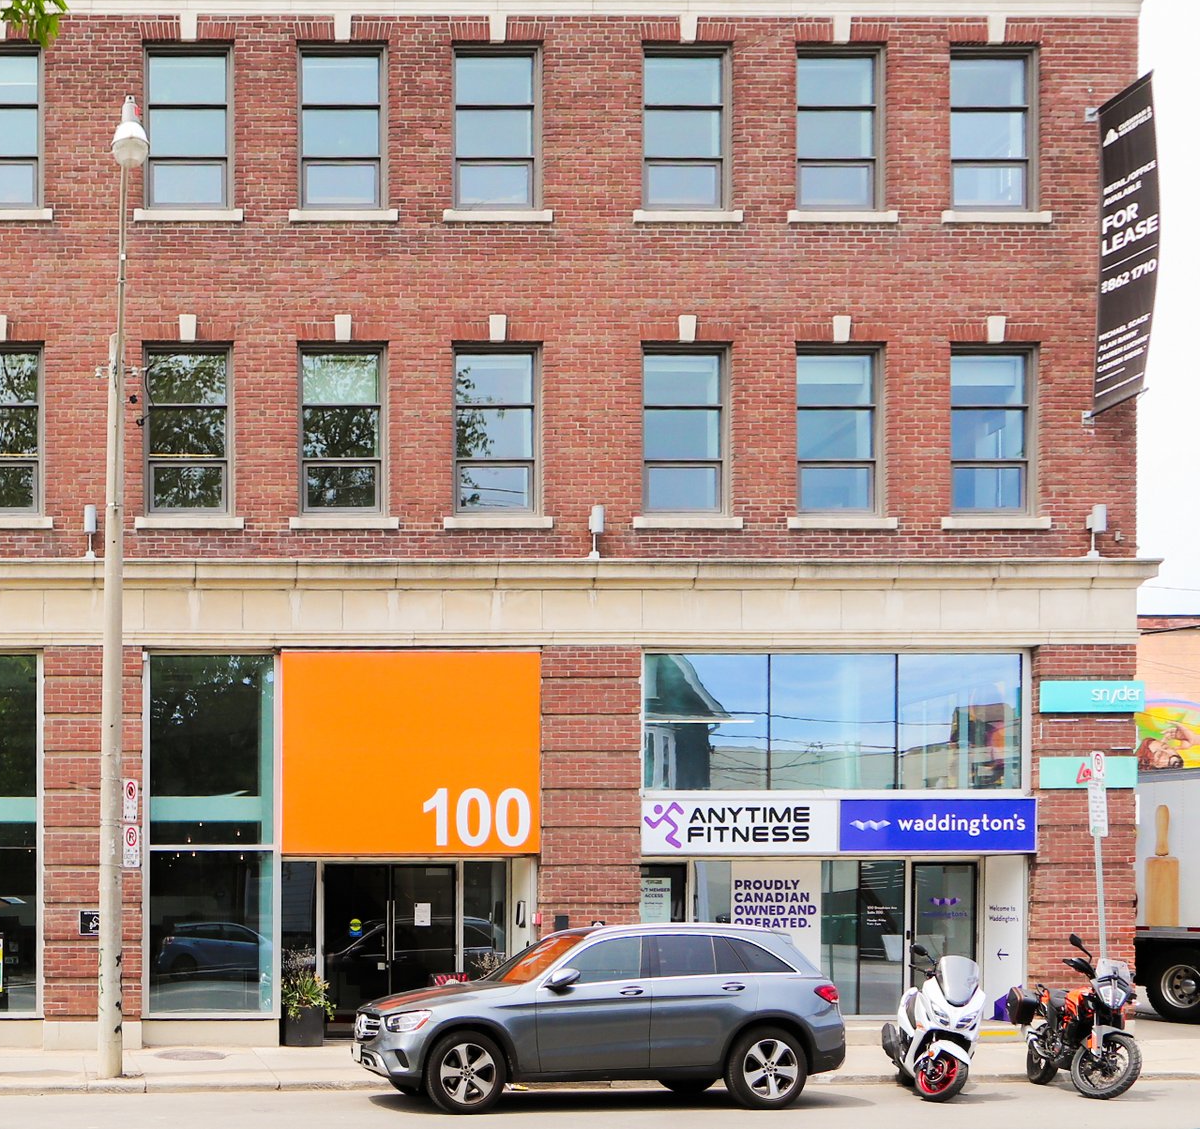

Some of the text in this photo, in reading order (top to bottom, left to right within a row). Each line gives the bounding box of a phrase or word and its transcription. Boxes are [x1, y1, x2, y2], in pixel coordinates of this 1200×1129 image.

[1103, 180, 1142, 207] AVAILABLE
[1102, 203, 1139, 234] FOR
[1102, 214, 1158, 256] LEASE
[1130, 258, 1157, 279] 1710
[422, 787, 531, 847] 100
[689, 806, 810, 823] ANYTIME
[897, 813, 1026, 836] waddington's
[687, 826, 810, 843] FITNESS
[734, 879, 800, 890] PROUDLY
[734, 892, 810, 903] CANADIAN
[734, 905, 817, 916] OWNED AND
[989, 904, 1010, 912] Welcome
[734, 917, 811, 928] OPERATED.
